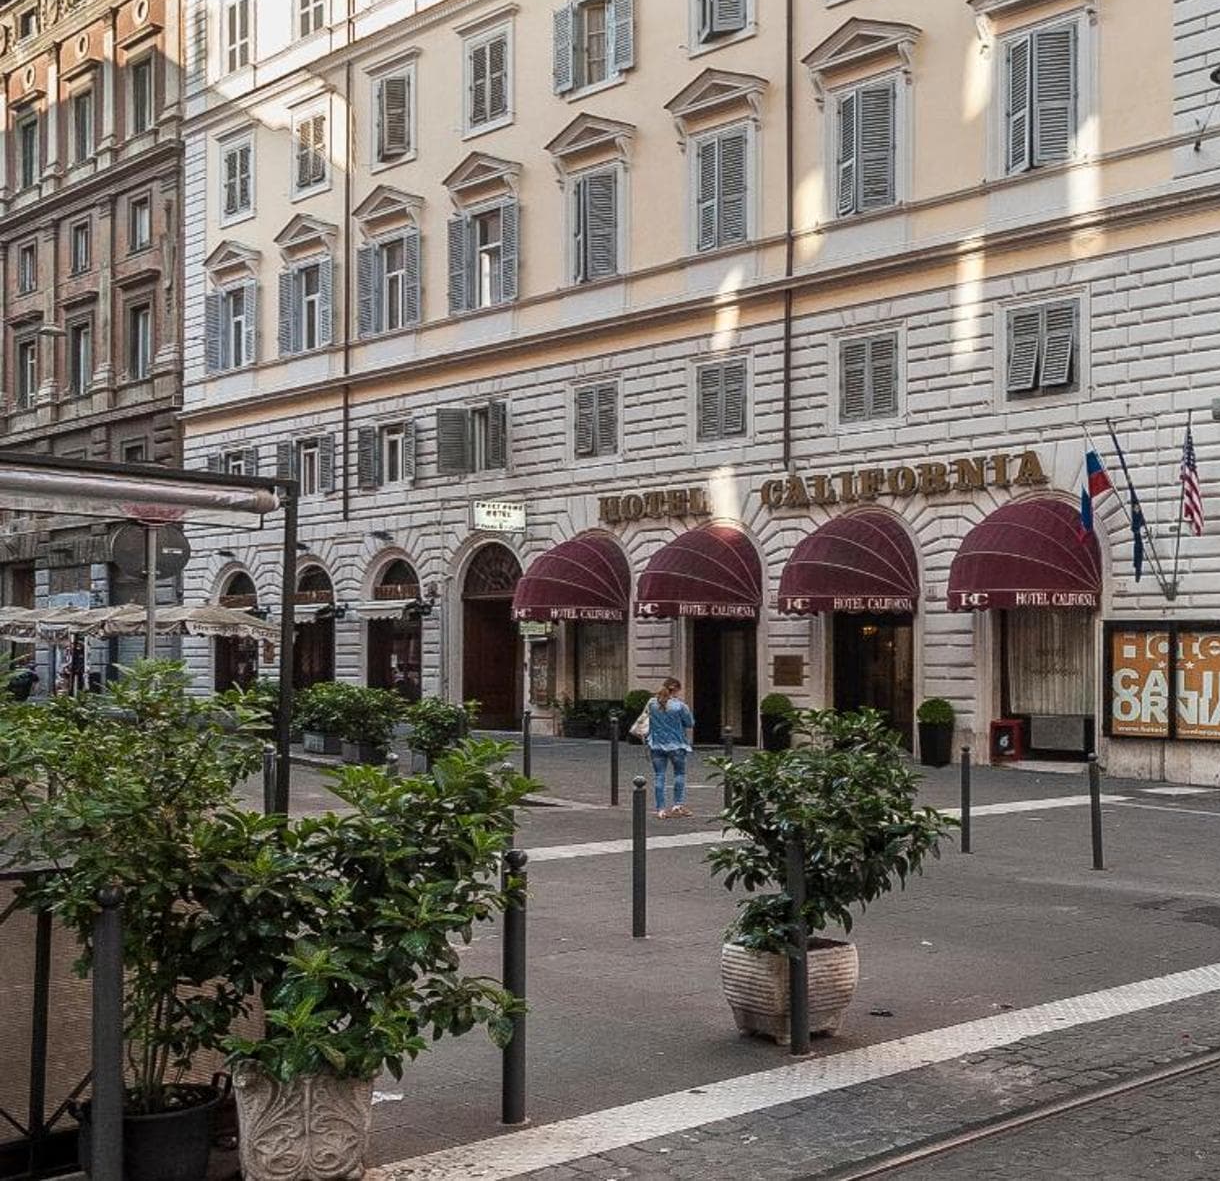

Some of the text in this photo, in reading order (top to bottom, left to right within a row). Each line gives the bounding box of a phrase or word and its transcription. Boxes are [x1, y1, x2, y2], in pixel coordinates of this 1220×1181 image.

[598, 450, 1049, 523] HOTEL CALIFORNIA
[834, 597, 865, 609] HOTEL
[867, 597, 913, 611] CALIFORNIA
[1016, 592, 1049, 605] HOTEL
[1052, 592, 1096, 607] CALIFORNIA
[550, 607, 578, 619] HOTEL
[680, 603, 709, 616] HOTEL
[711, 604, 755, 618] CALIFORNIA
